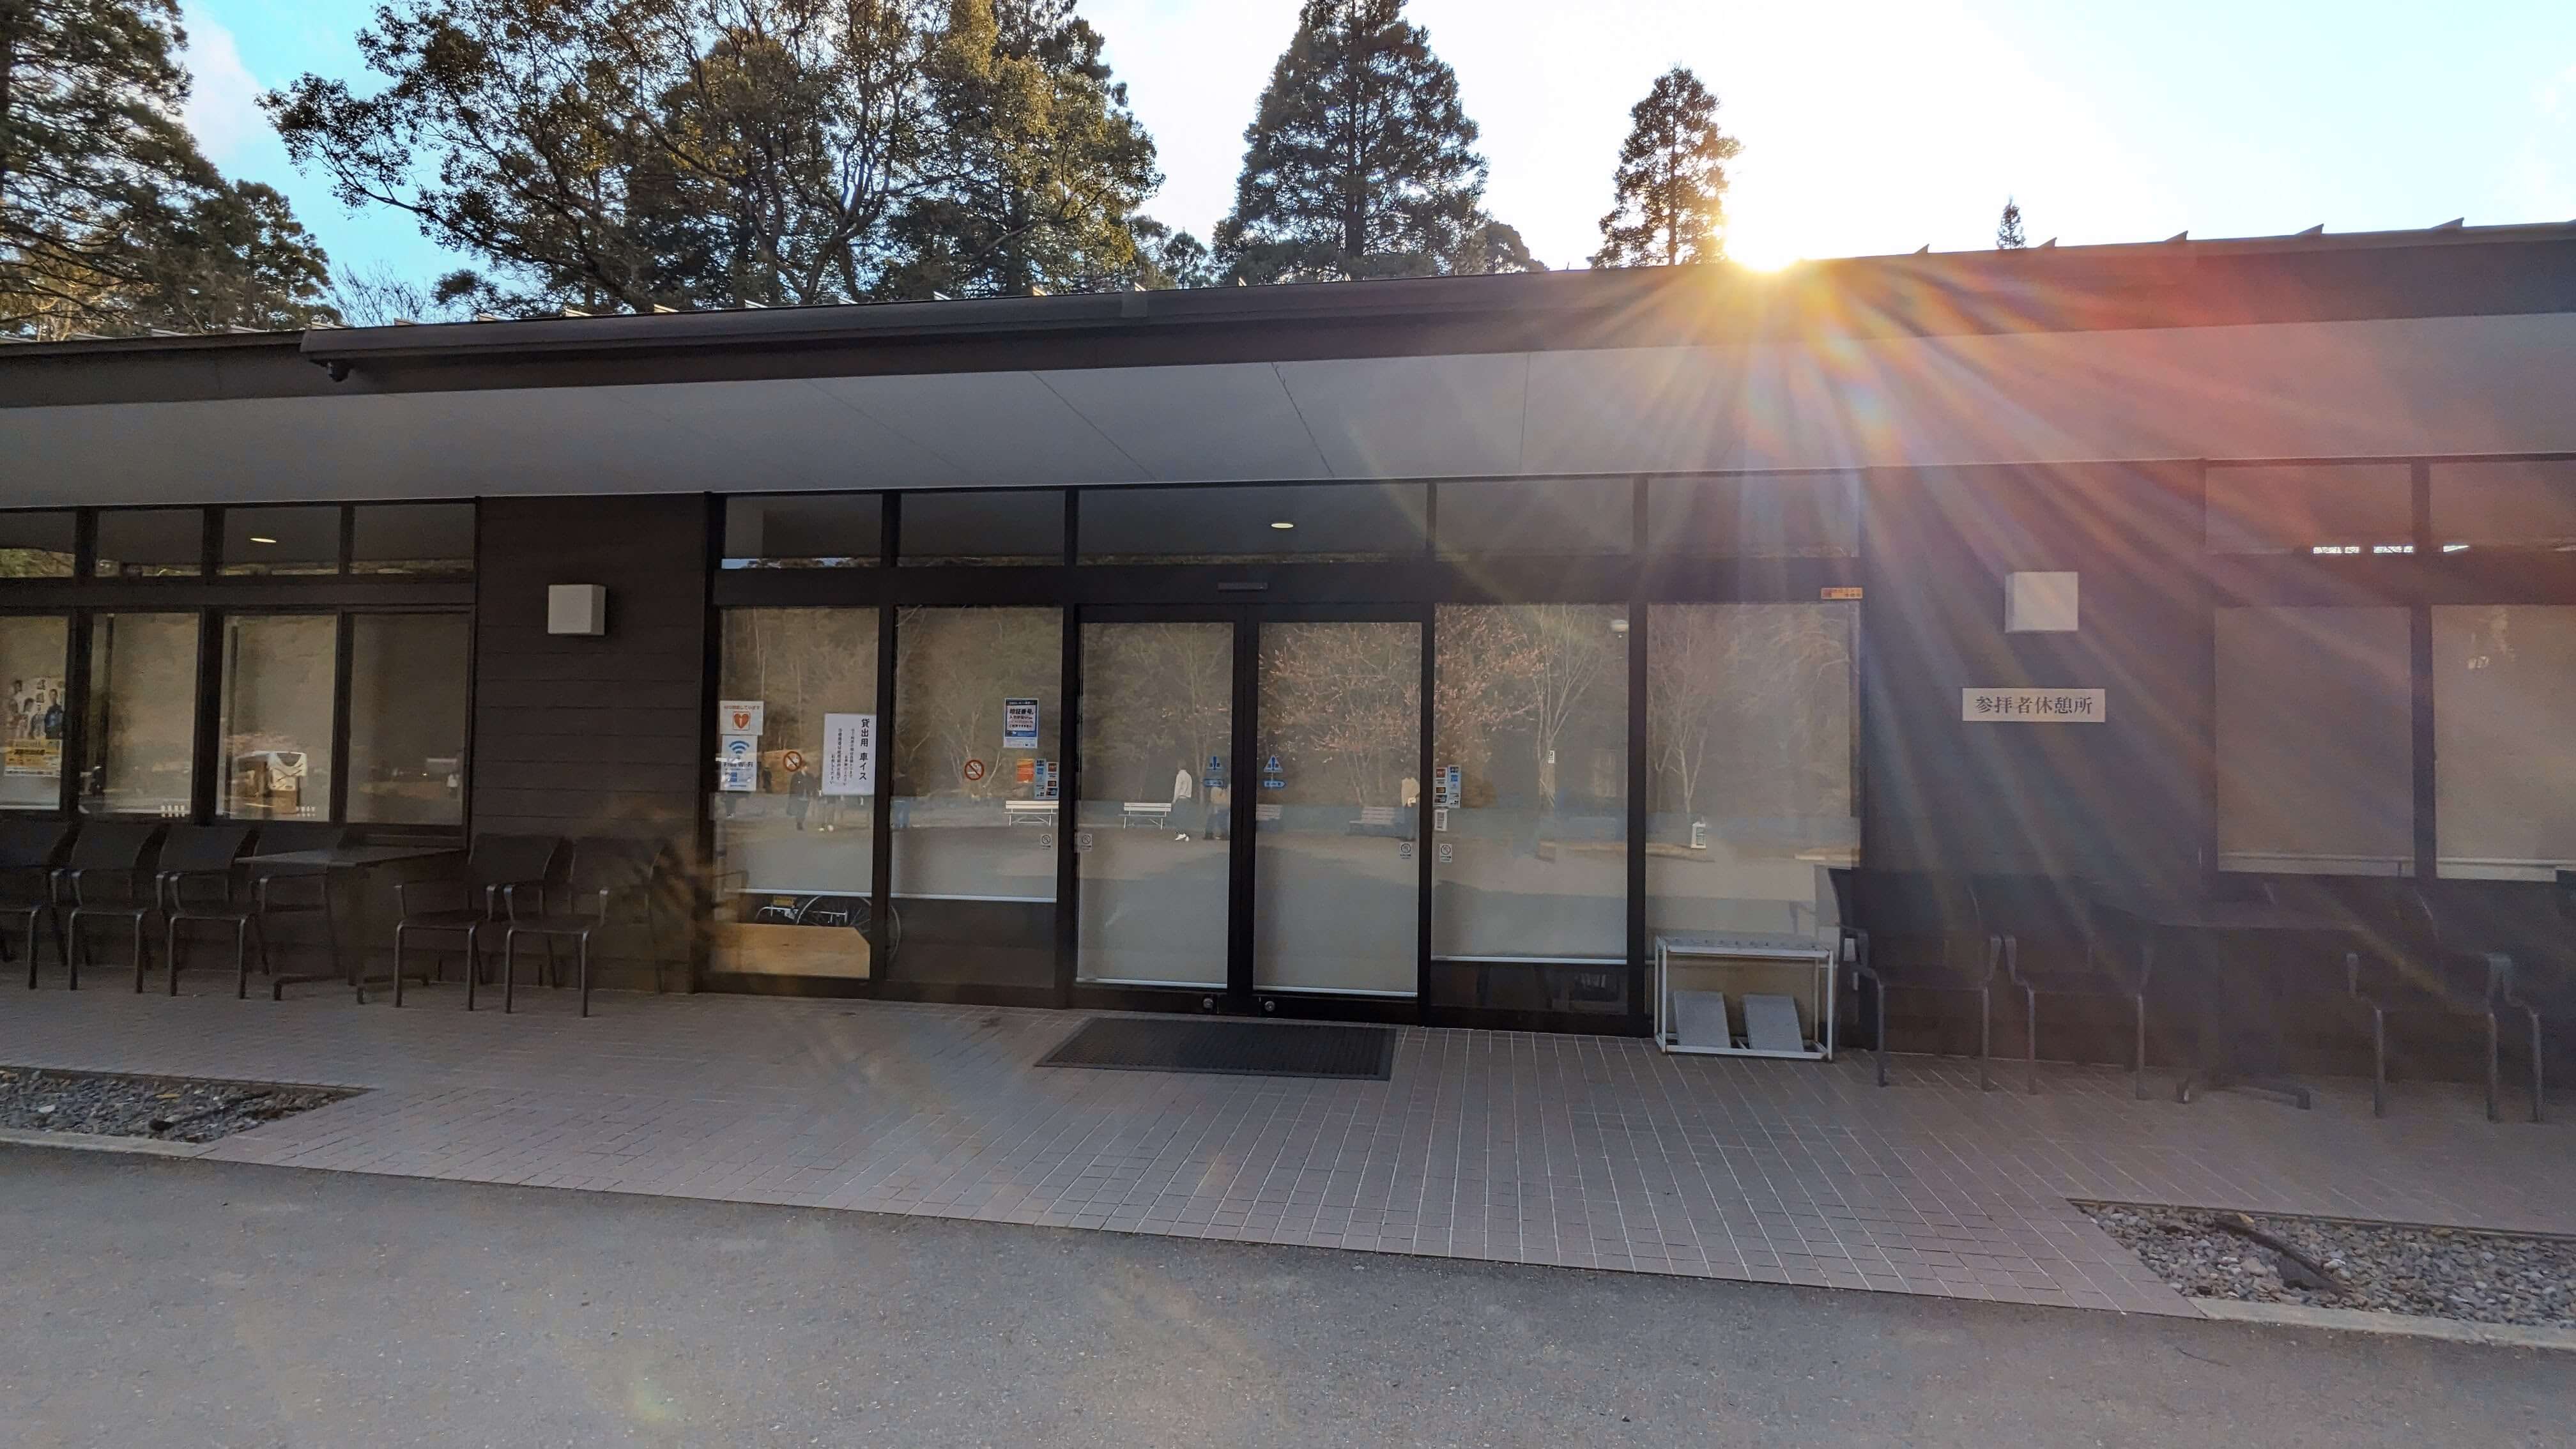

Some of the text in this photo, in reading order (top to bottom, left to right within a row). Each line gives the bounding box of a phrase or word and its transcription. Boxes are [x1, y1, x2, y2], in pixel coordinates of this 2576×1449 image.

[1975, 696, 2093, 714] 参拝者休憩所
[859, 718, 870, 780] 貸出用 車イス
